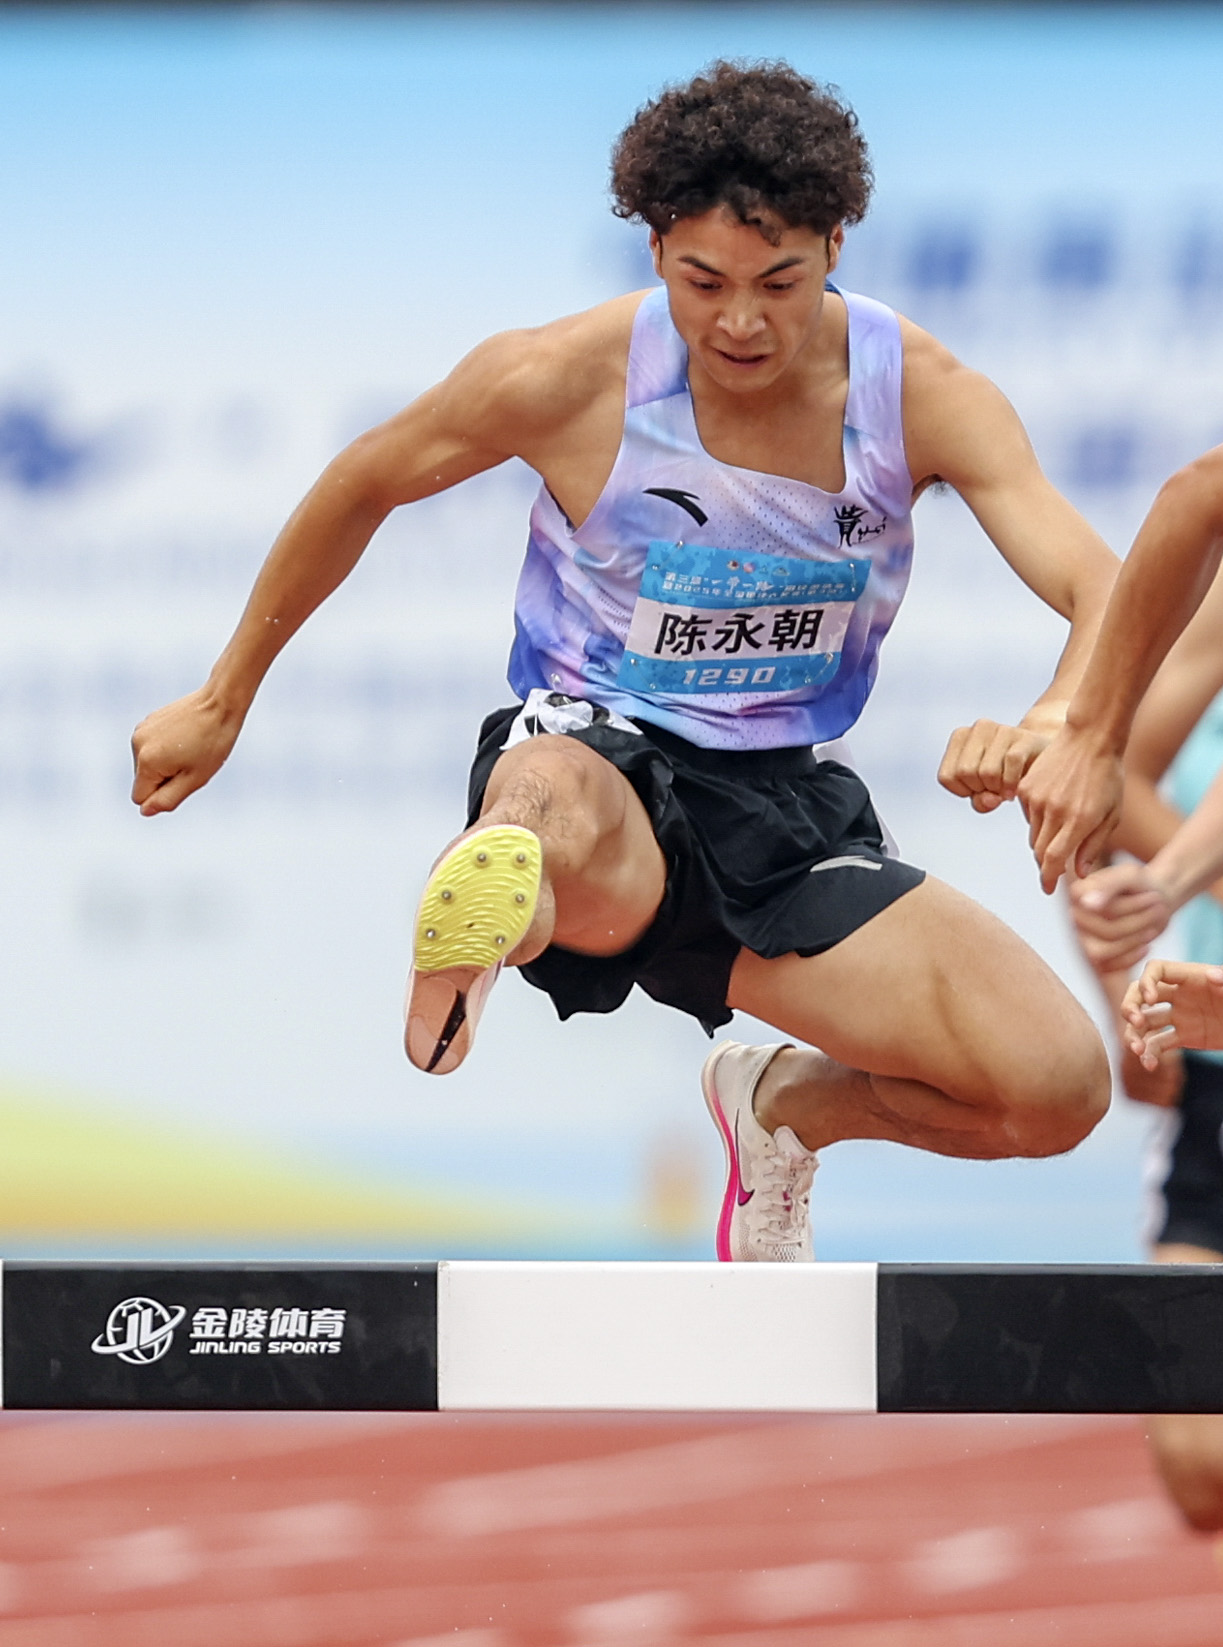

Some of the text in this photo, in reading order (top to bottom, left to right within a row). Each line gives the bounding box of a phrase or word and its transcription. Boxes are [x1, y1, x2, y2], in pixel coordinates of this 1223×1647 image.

[654, 608, 824, 655] 陈永朝
[682, 666, 776, 686] 1290
[189, 1307, 347, 1340] 金陵体育
[189, 1341, 342, 1355] JINLING SPORTS
